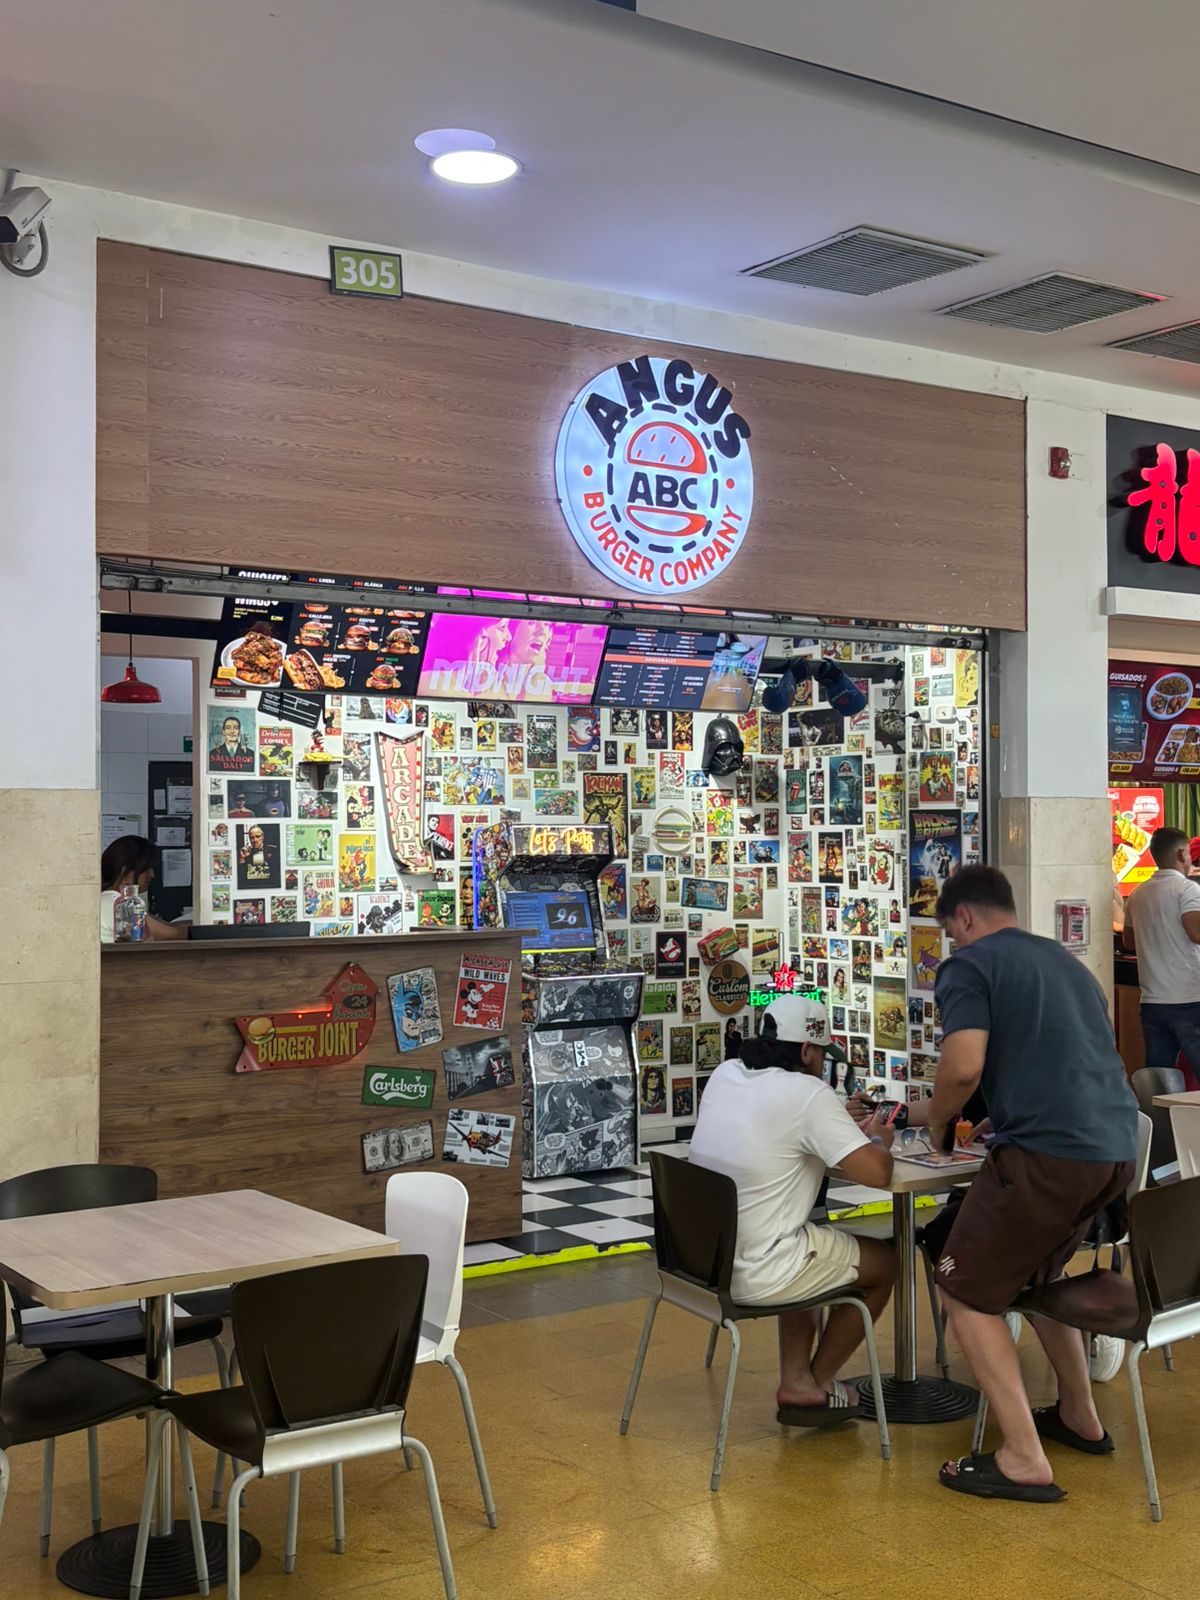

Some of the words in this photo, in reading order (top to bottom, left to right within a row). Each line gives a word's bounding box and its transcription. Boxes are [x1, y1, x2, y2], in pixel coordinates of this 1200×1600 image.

[341, 256, 395, 289] 305
[585, 355, 751, 458] ANGUS
[627, 472, 698, 510] ABC
[584, 492, 655, 582] BURGER
[660, 505, 743, 586] COMPANY
[429, 659, 589, 696] MIDNIGHT
[1109, 673, 1142, 682] GUISADOS
[211, 754, 253, 764] SALVADOR
[391, 747, 419, 859] ARCADE
[463, 969, 481, 979] WILD
[483, 970, 506, 982] WAVES
[645, 983, 677, 994] afalda
[710, 976, 749, 996] Custom
[257, 1035, 316, 1064] BURGER
[318, 1021, 360, 1059] JOINT
[369, 1072, 428, 1099] Carlsberg
